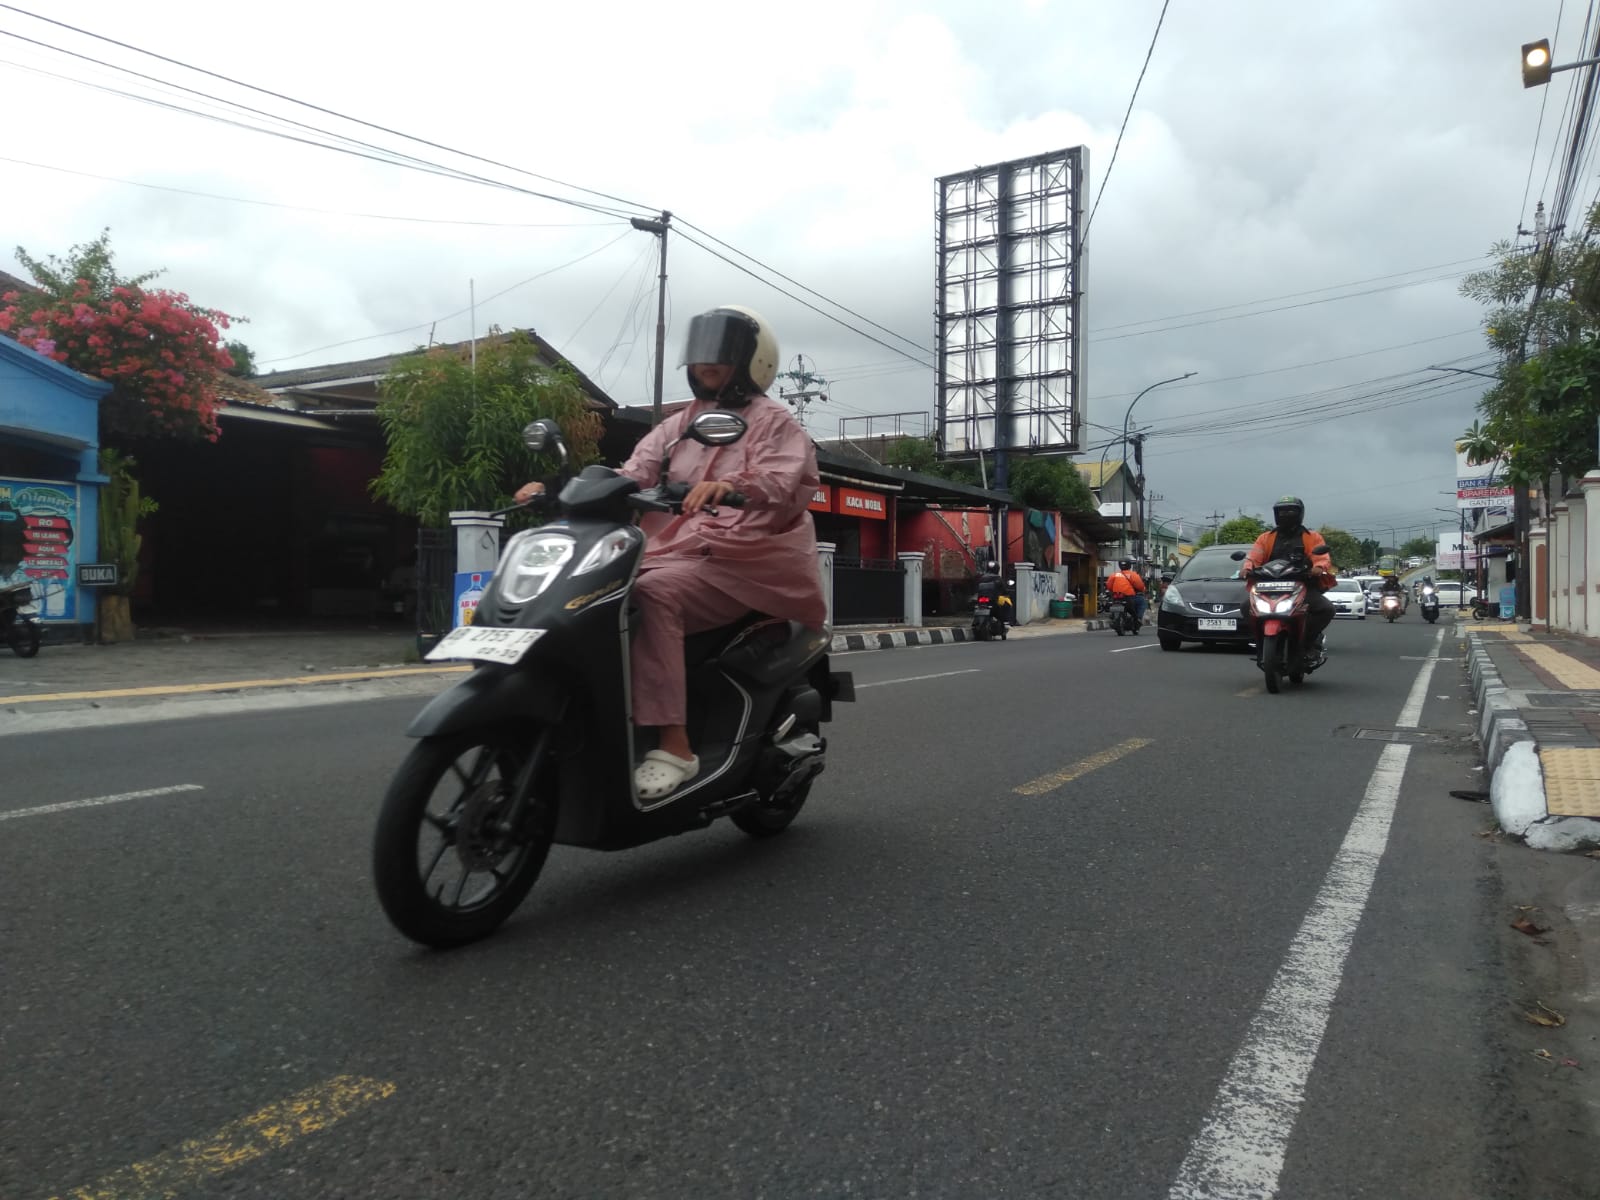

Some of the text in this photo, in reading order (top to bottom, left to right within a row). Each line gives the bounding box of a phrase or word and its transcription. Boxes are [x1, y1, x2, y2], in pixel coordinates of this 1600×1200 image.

[846, 496, 883, 511] KACA MOBIL
[81, 568, 114, 581] BUKA
